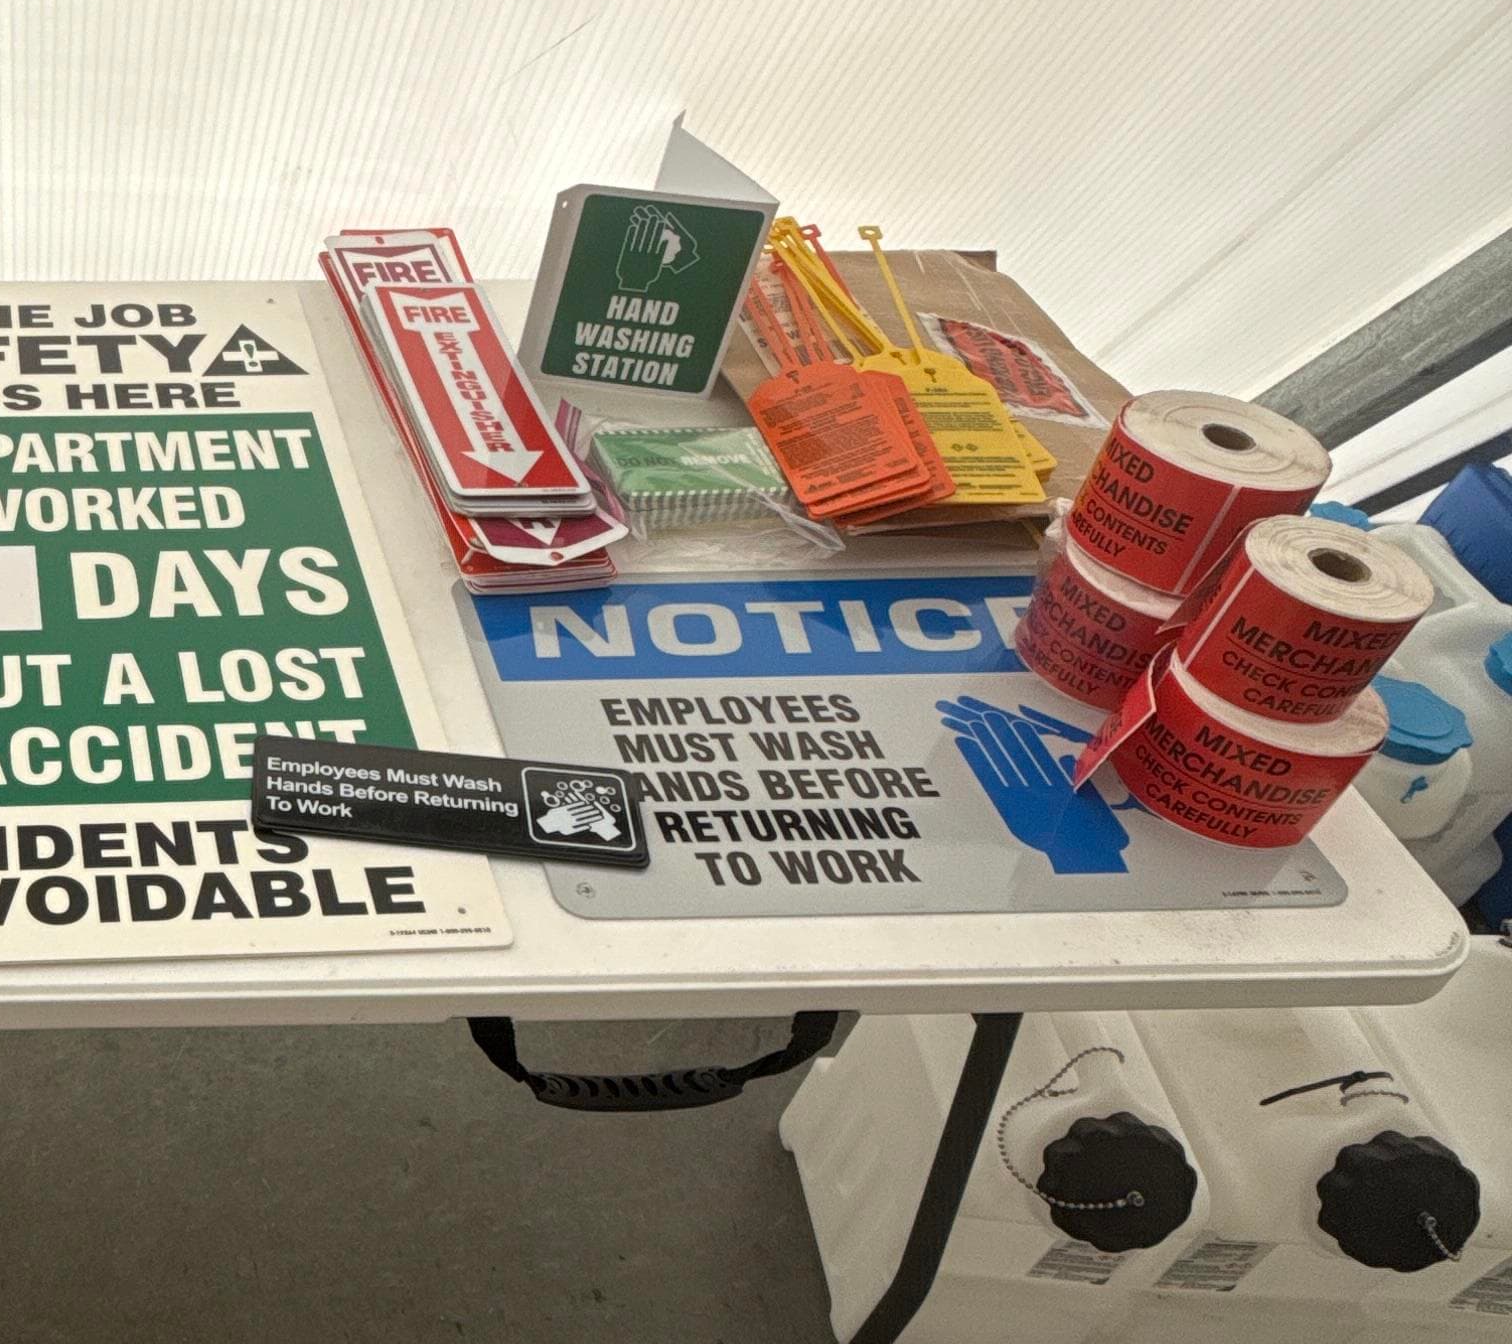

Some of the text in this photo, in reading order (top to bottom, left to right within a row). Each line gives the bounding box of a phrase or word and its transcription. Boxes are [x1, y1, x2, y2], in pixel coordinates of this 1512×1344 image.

[352, 261, 441, 287] FIRE
[73, 303, 197, 328] JOB
[403, 306, 471, 323] FIRE
[606, 295, 680, 325] HAND
[575, 322, 695, 358] WASHING
[572, 352, 679, 385] STATION
[65, 382, 242, 410] HERE
[434, 332, 515, 452] EXTINGUISHER
[1086, 498, 1168, 555] CONTENTS
[69, 546, 350, 621] DAYS
[1060, 575, 1127, 632] MIXED
[101, 652, 158, 707] A
[182, 646, 368, 703] LOST
[1222, 650, 1298, 693] CHECK
[599, 694, 861, 727] EMPLOYEES
[615, 729, 885, 764] MUST WASH
[1144, 716, 1331, 805] MERCHANDISE
[1194, 725, 1292, 776] MIXED
[266, 756, 502, 793] Employees Must Wash
[631, 767, 941, 802] ANDS BEFORE
[1136, 744, 1304, 826] CHECK CONTENTS
[266, 776, 519, 817] Hands Before Returning
[266, 796, 353, 818] To Work
[1145, 783, 1258, 839] CAREFULLY
[654, 807, 921, 844] RETURNING
[695, 850, 922, 886] TO WORK
